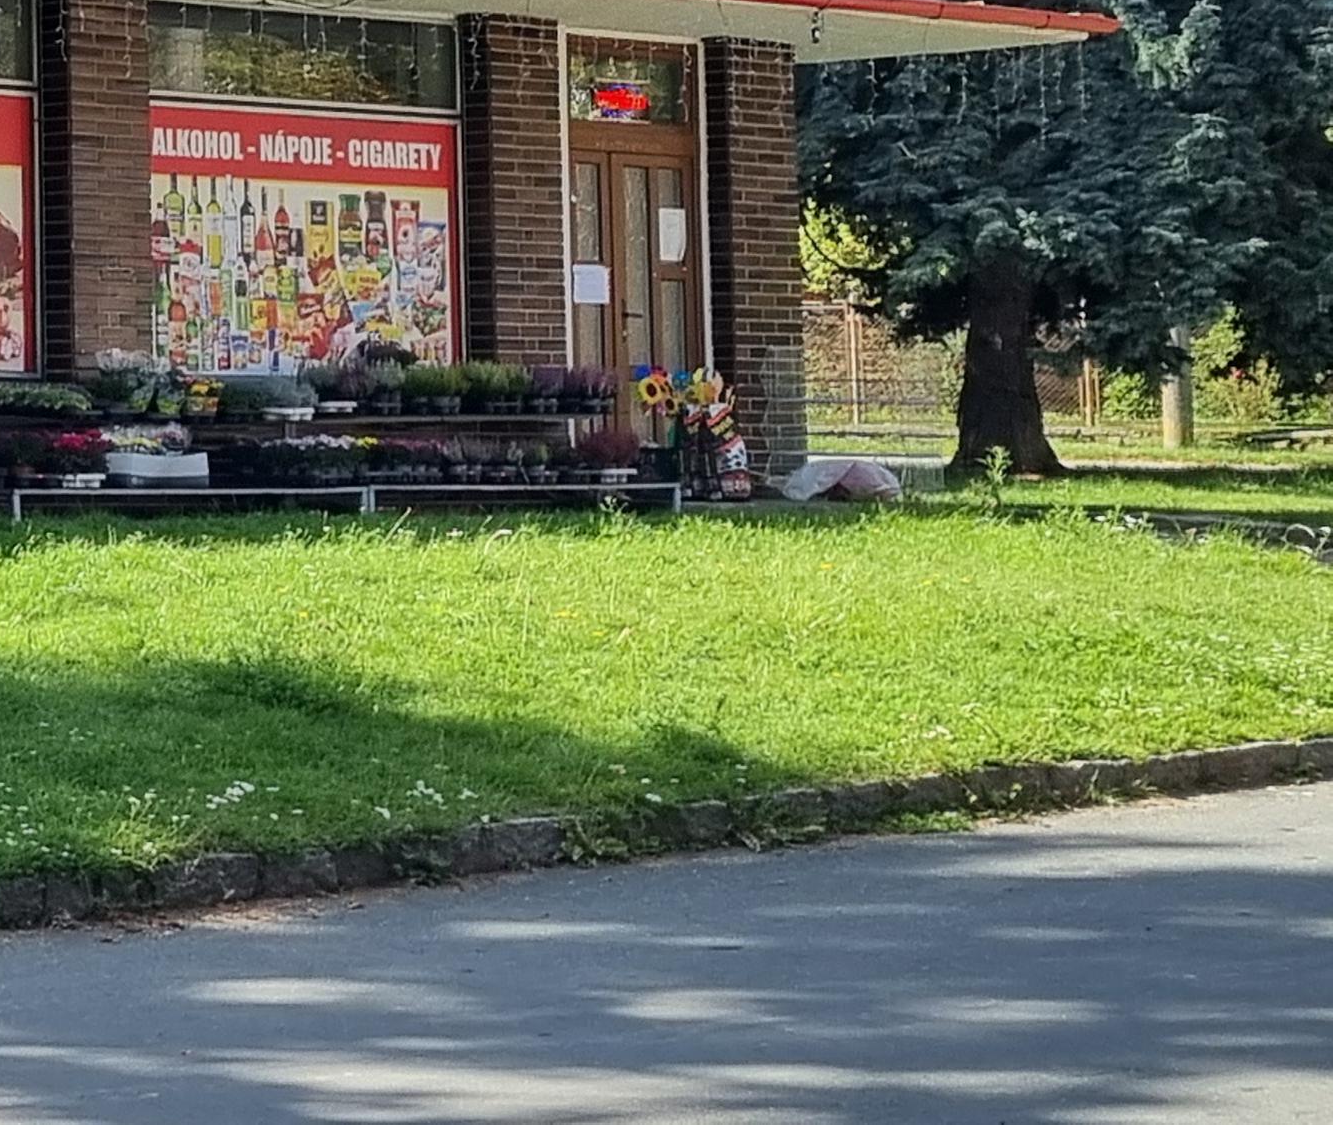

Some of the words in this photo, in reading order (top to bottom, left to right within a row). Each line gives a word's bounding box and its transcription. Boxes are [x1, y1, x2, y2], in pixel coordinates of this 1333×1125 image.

[151, 127, 244, 161] ALKOHOL
[259, 129, 333, 166] NÁPOJE
[348, 138, 442, 172] CIGARETY
